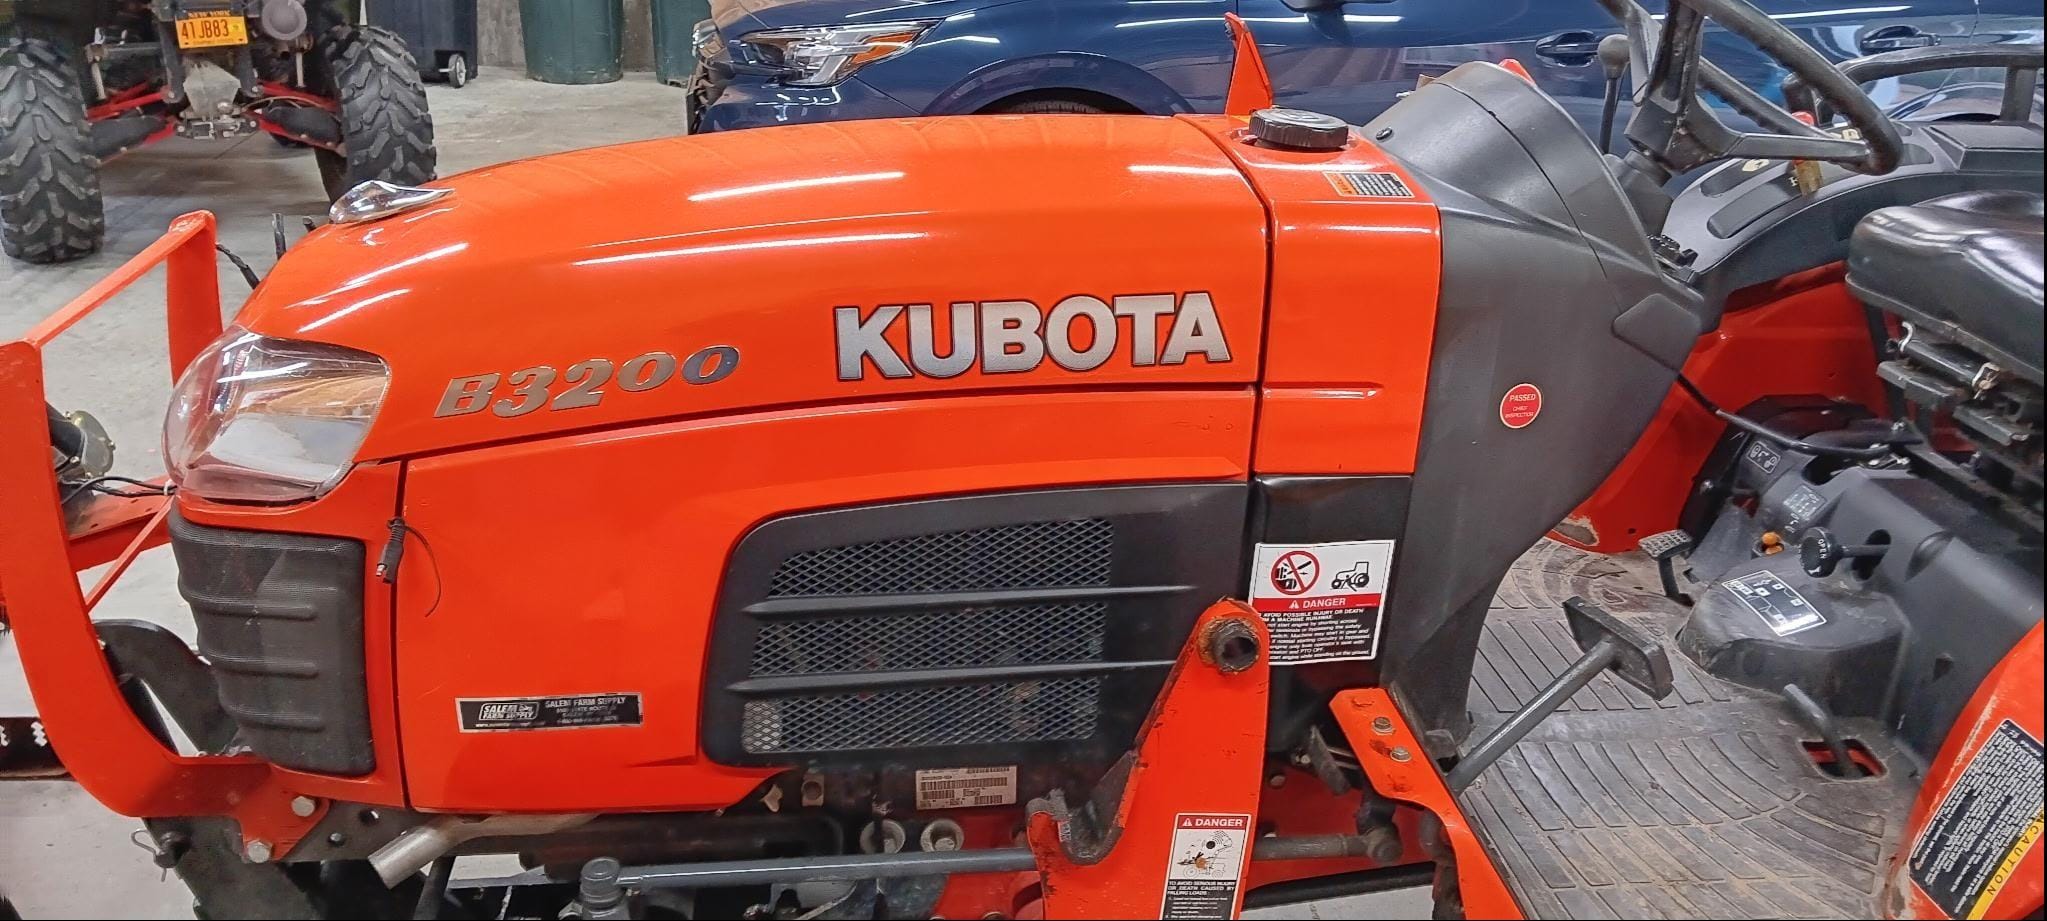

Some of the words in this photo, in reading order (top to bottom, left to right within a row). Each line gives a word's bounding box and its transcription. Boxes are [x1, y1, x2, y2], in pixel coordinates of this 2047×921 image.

[181, 19, 229, 40] 41JB83
[834, 292, 1231, 380] KUBOTA
[433, 345, 739, 417] B3200
[1818, 538, 1827, 558] OPEN
[1302, 598, 1346, 608] DANGER
[484, 704, 517, 712] SALEM
[545, 699, 571, 708] SALEM
[574, 698, 595, 706] FARM
[597, 697, 625, 705] SUPPLY
[1987, 826, 2039, 895] CAUTION
